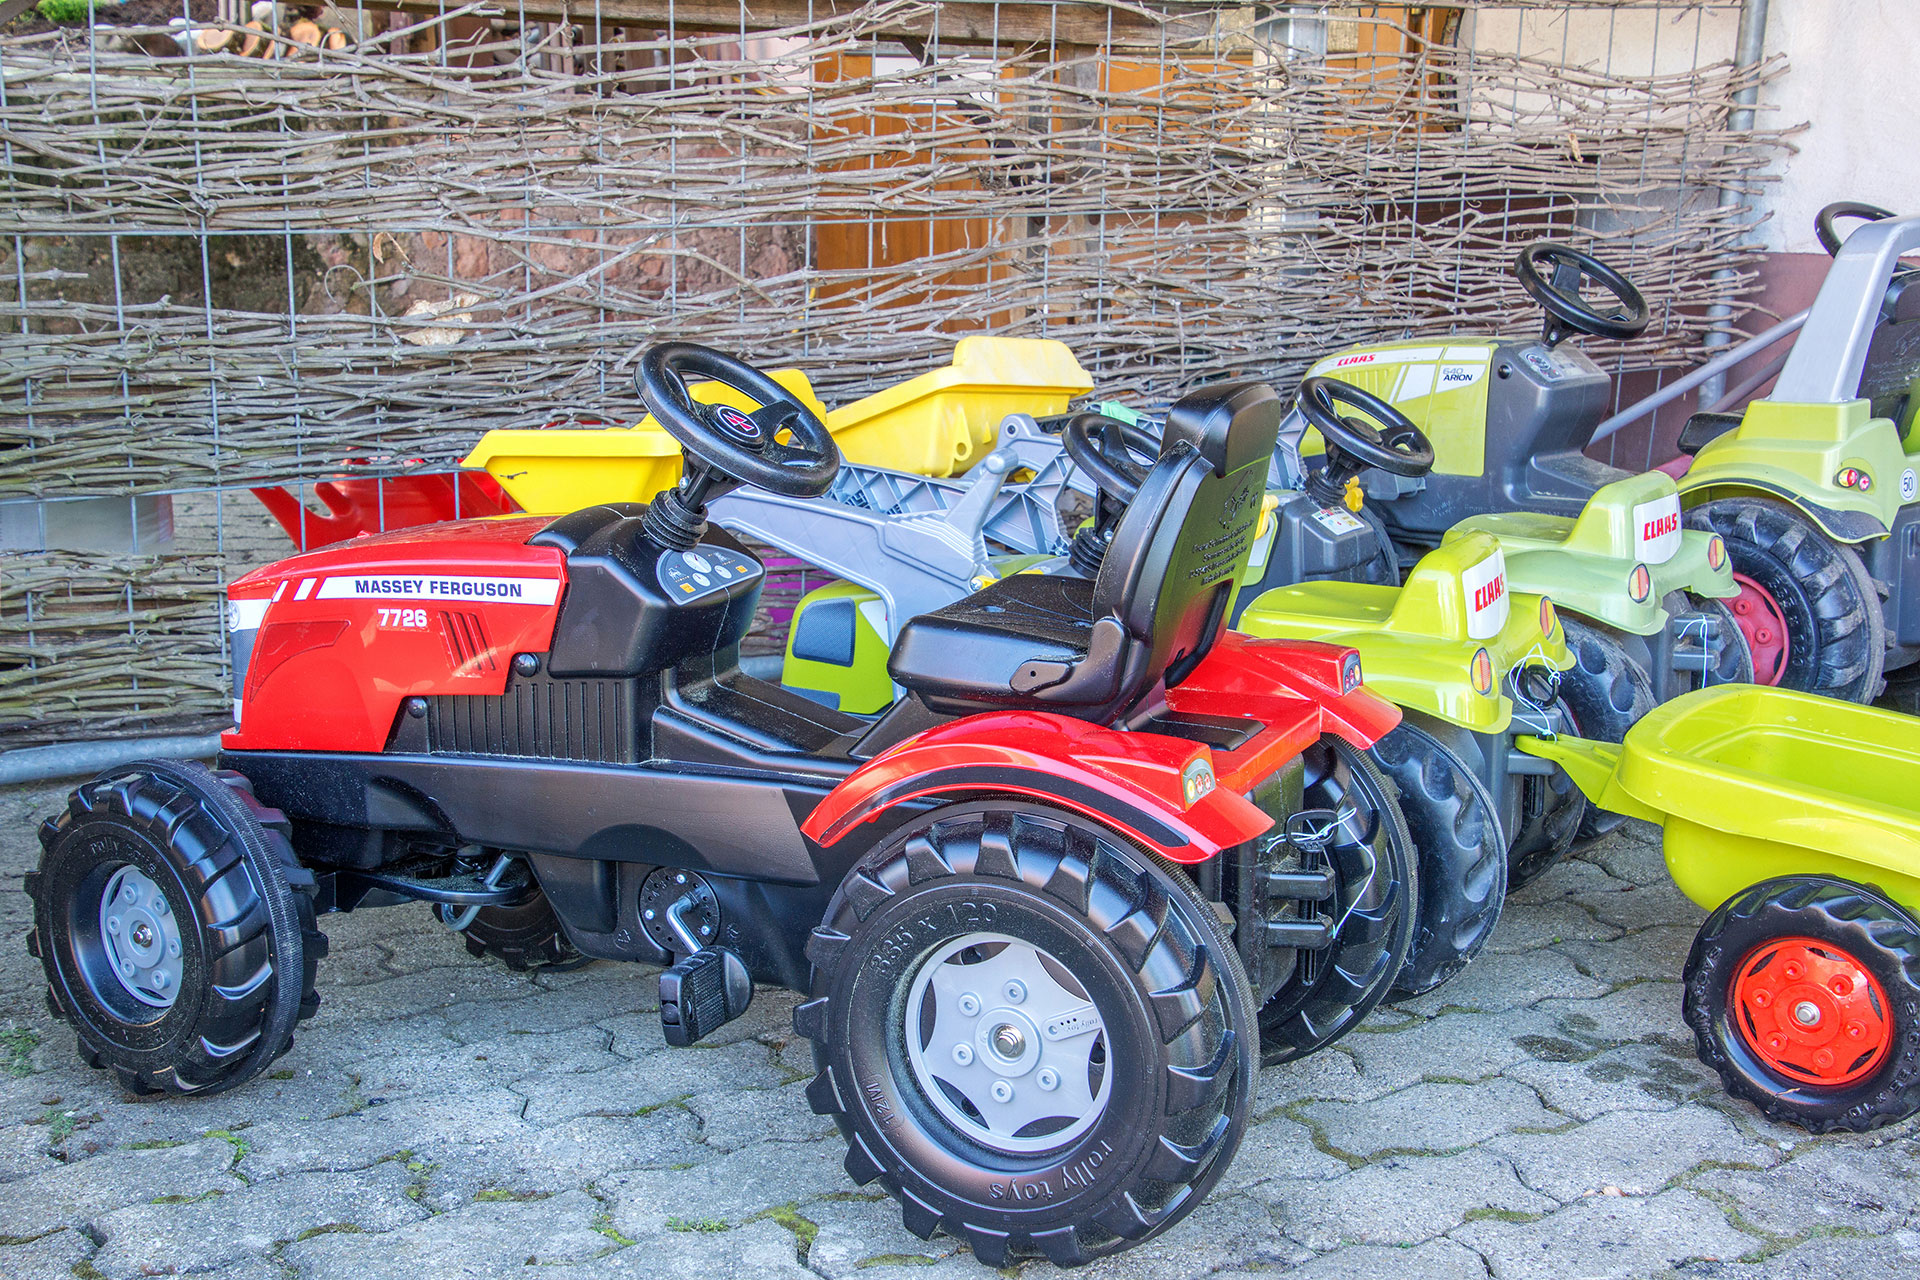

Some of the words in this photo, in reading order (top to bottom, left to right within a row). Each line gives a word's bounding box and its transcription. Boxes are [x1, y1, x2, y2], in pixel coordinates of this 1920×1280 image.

[1337, 354, 1376, 366] CLAAS
[1903, 477, 1914, 492] 50
[1643, 513, 1677, 541] CLAAS
[355, 579, 424, 594] MASSEY
[429, 581, 523, 598] FERGUSON
[1475, 573, 1504, 612] CLAAS
[377, 609, 428, 628] 7726
[871, 927, 915, 976] 335
[945, 902, 997, 923] 120
[1694, 946, 1722, 997] toys
[865, 1082, 893, 1127] 12M
[1063, 1139, 1114, 1193] rolly
[990, 1179, 1054, 1201] toys
